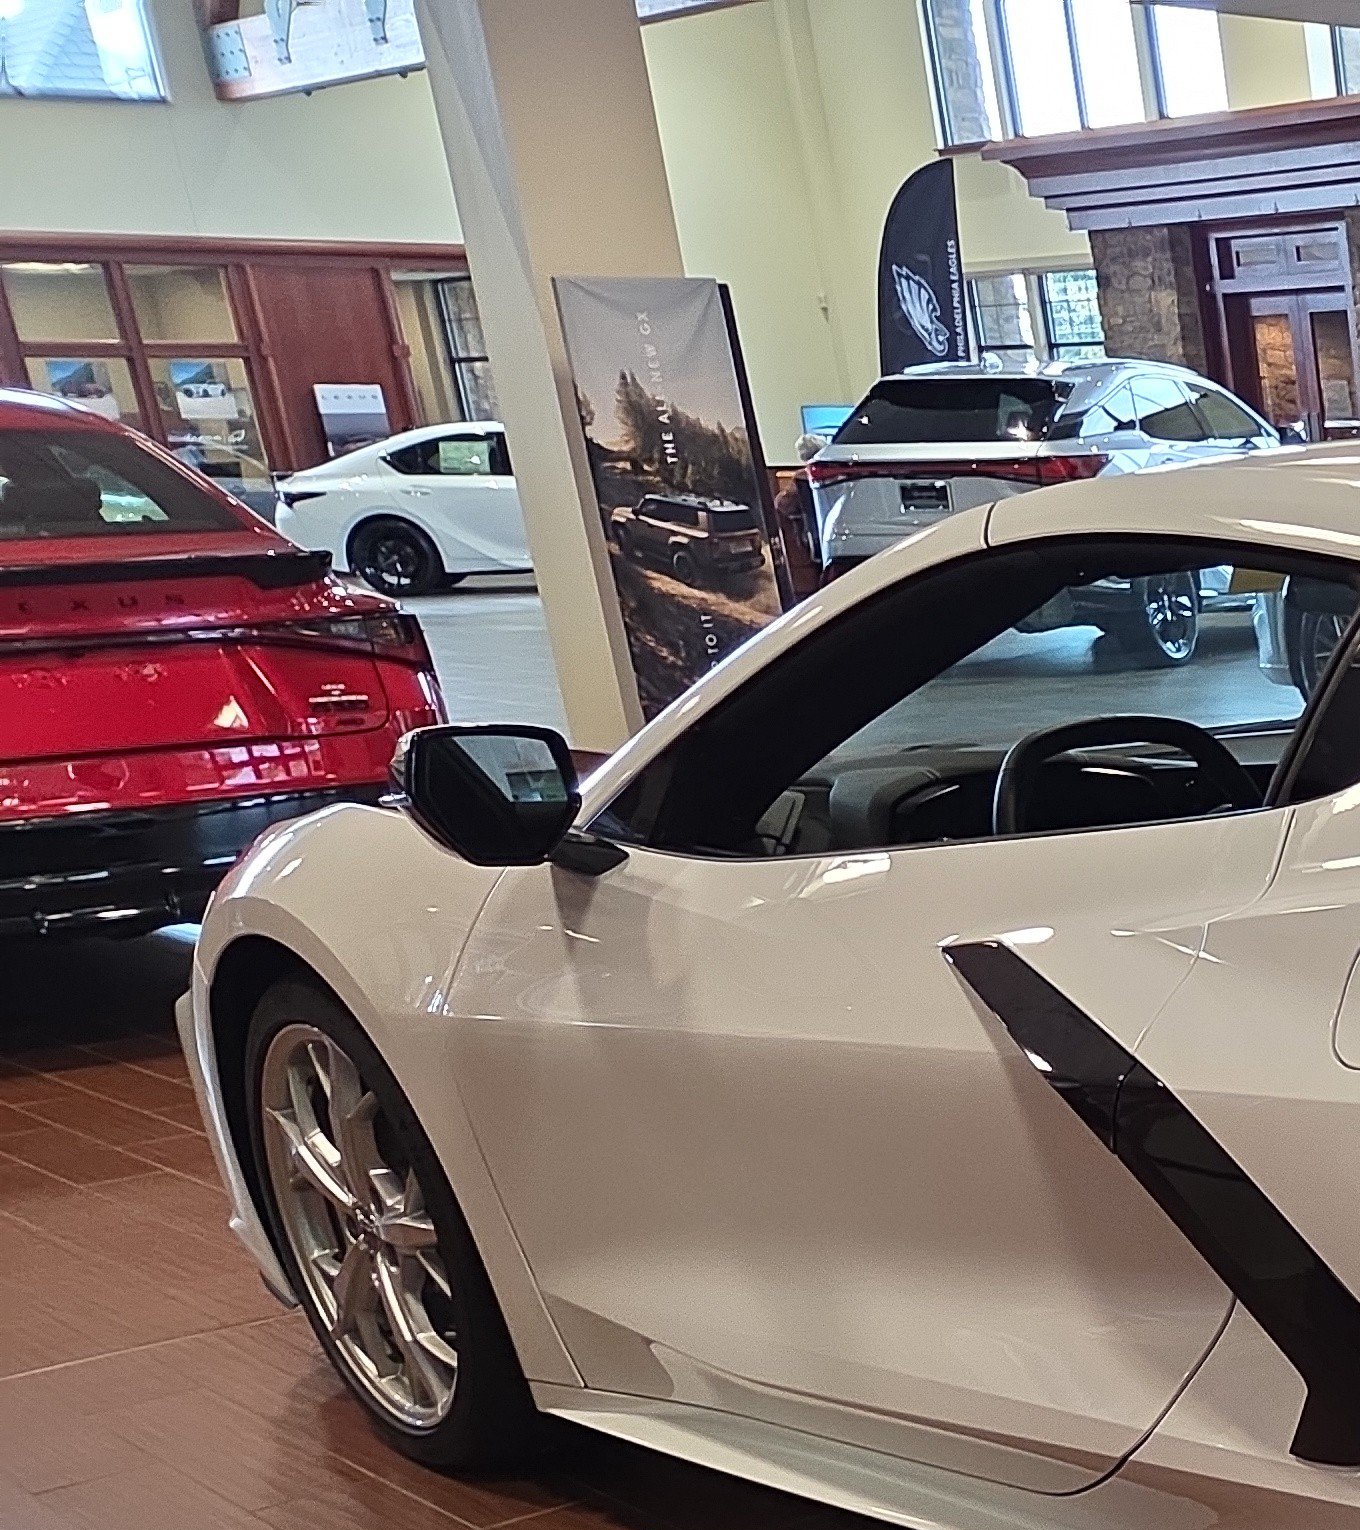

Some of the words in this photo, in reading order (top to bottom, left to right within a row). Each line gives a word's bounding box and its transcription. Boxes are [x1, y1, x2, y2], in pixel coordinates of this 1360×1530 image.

[946, 239, 957, 281] EAGLES
[636, 311, 651, 335] GX
[951, 281, 966, 357] PHILADELPHIA
[661, 431, 679, 465] THE
[700, 615, 714, 628] IT
[705, 633, 719, 655] TO
